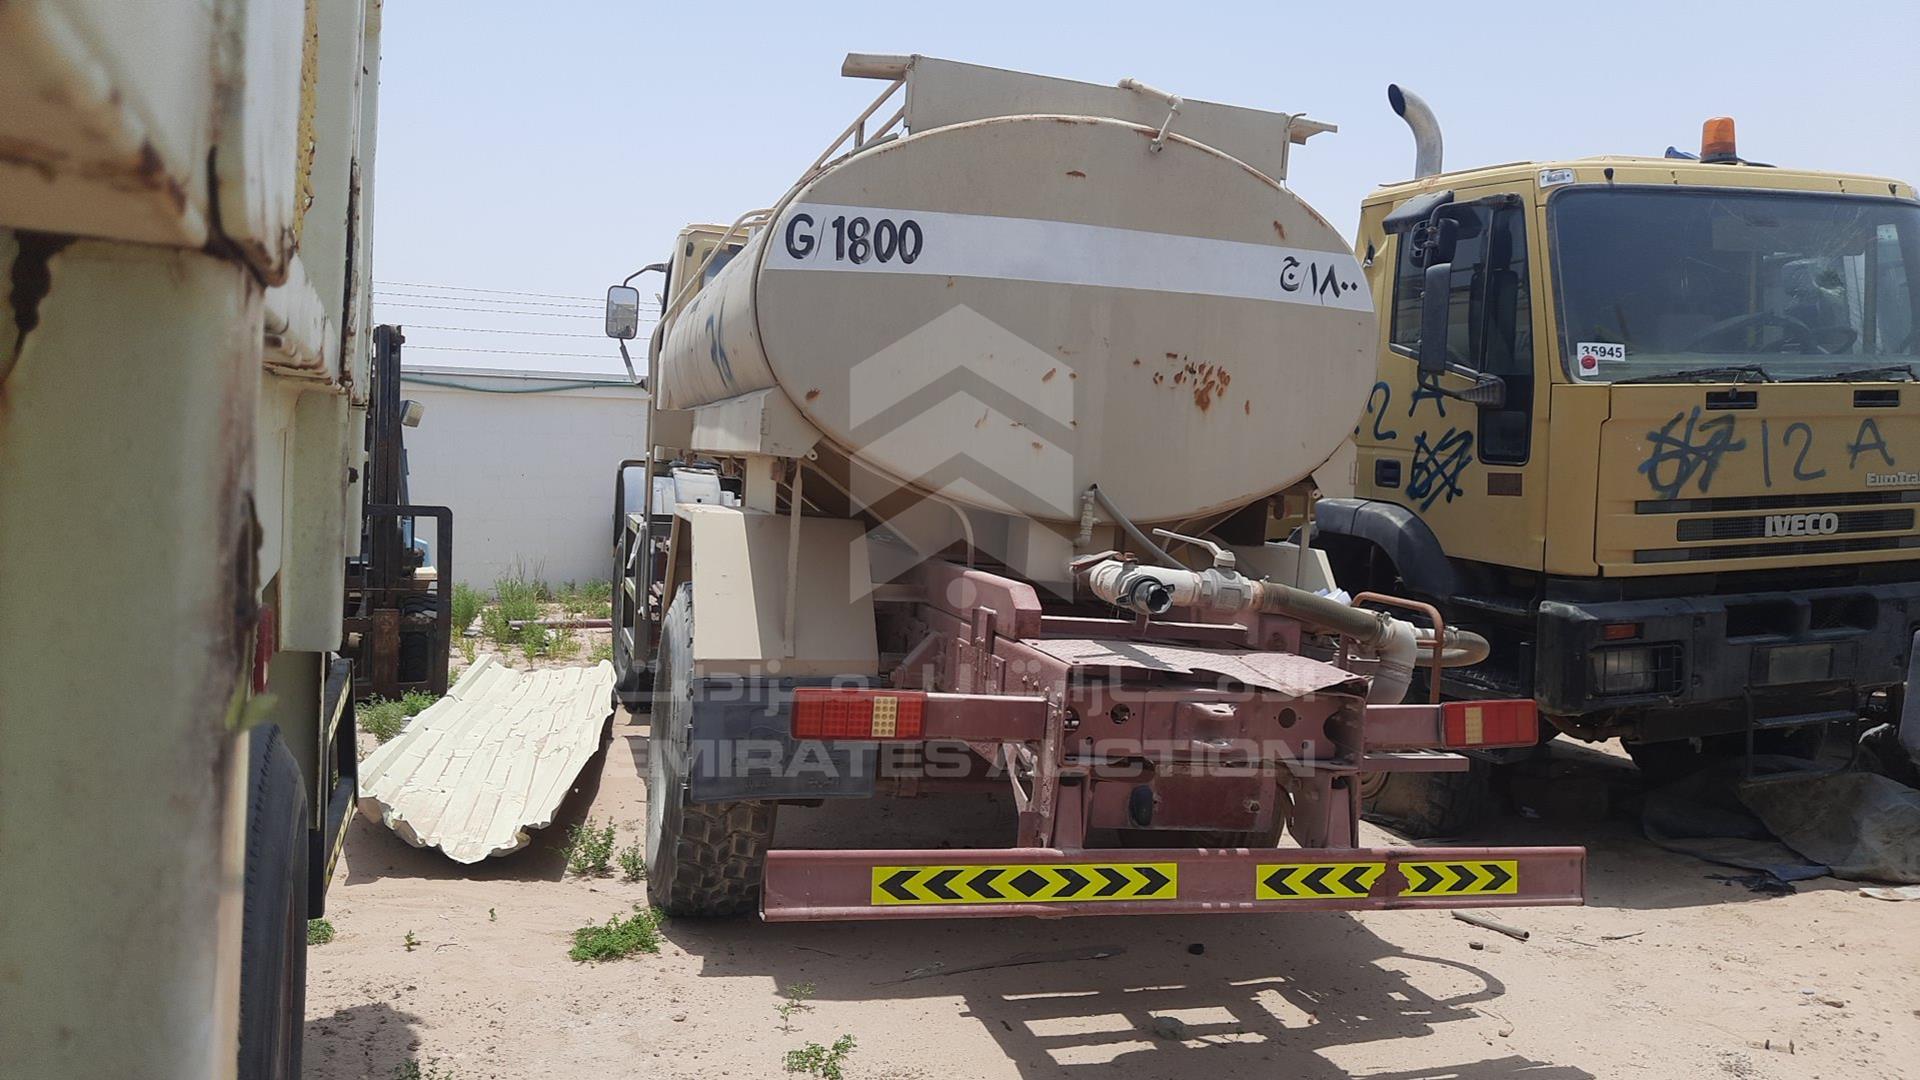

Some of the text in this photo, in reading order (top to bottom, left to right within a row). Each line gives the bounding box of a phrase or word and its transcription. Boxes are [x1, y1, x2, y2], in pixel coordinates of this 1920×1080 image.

[1582, 345, 1623, 358] 35945
[1847, 417, 1895, 469] A
[1866, 471, 1920, 486] EuroTra
[1764, 512, 1839, 537] IVECO
